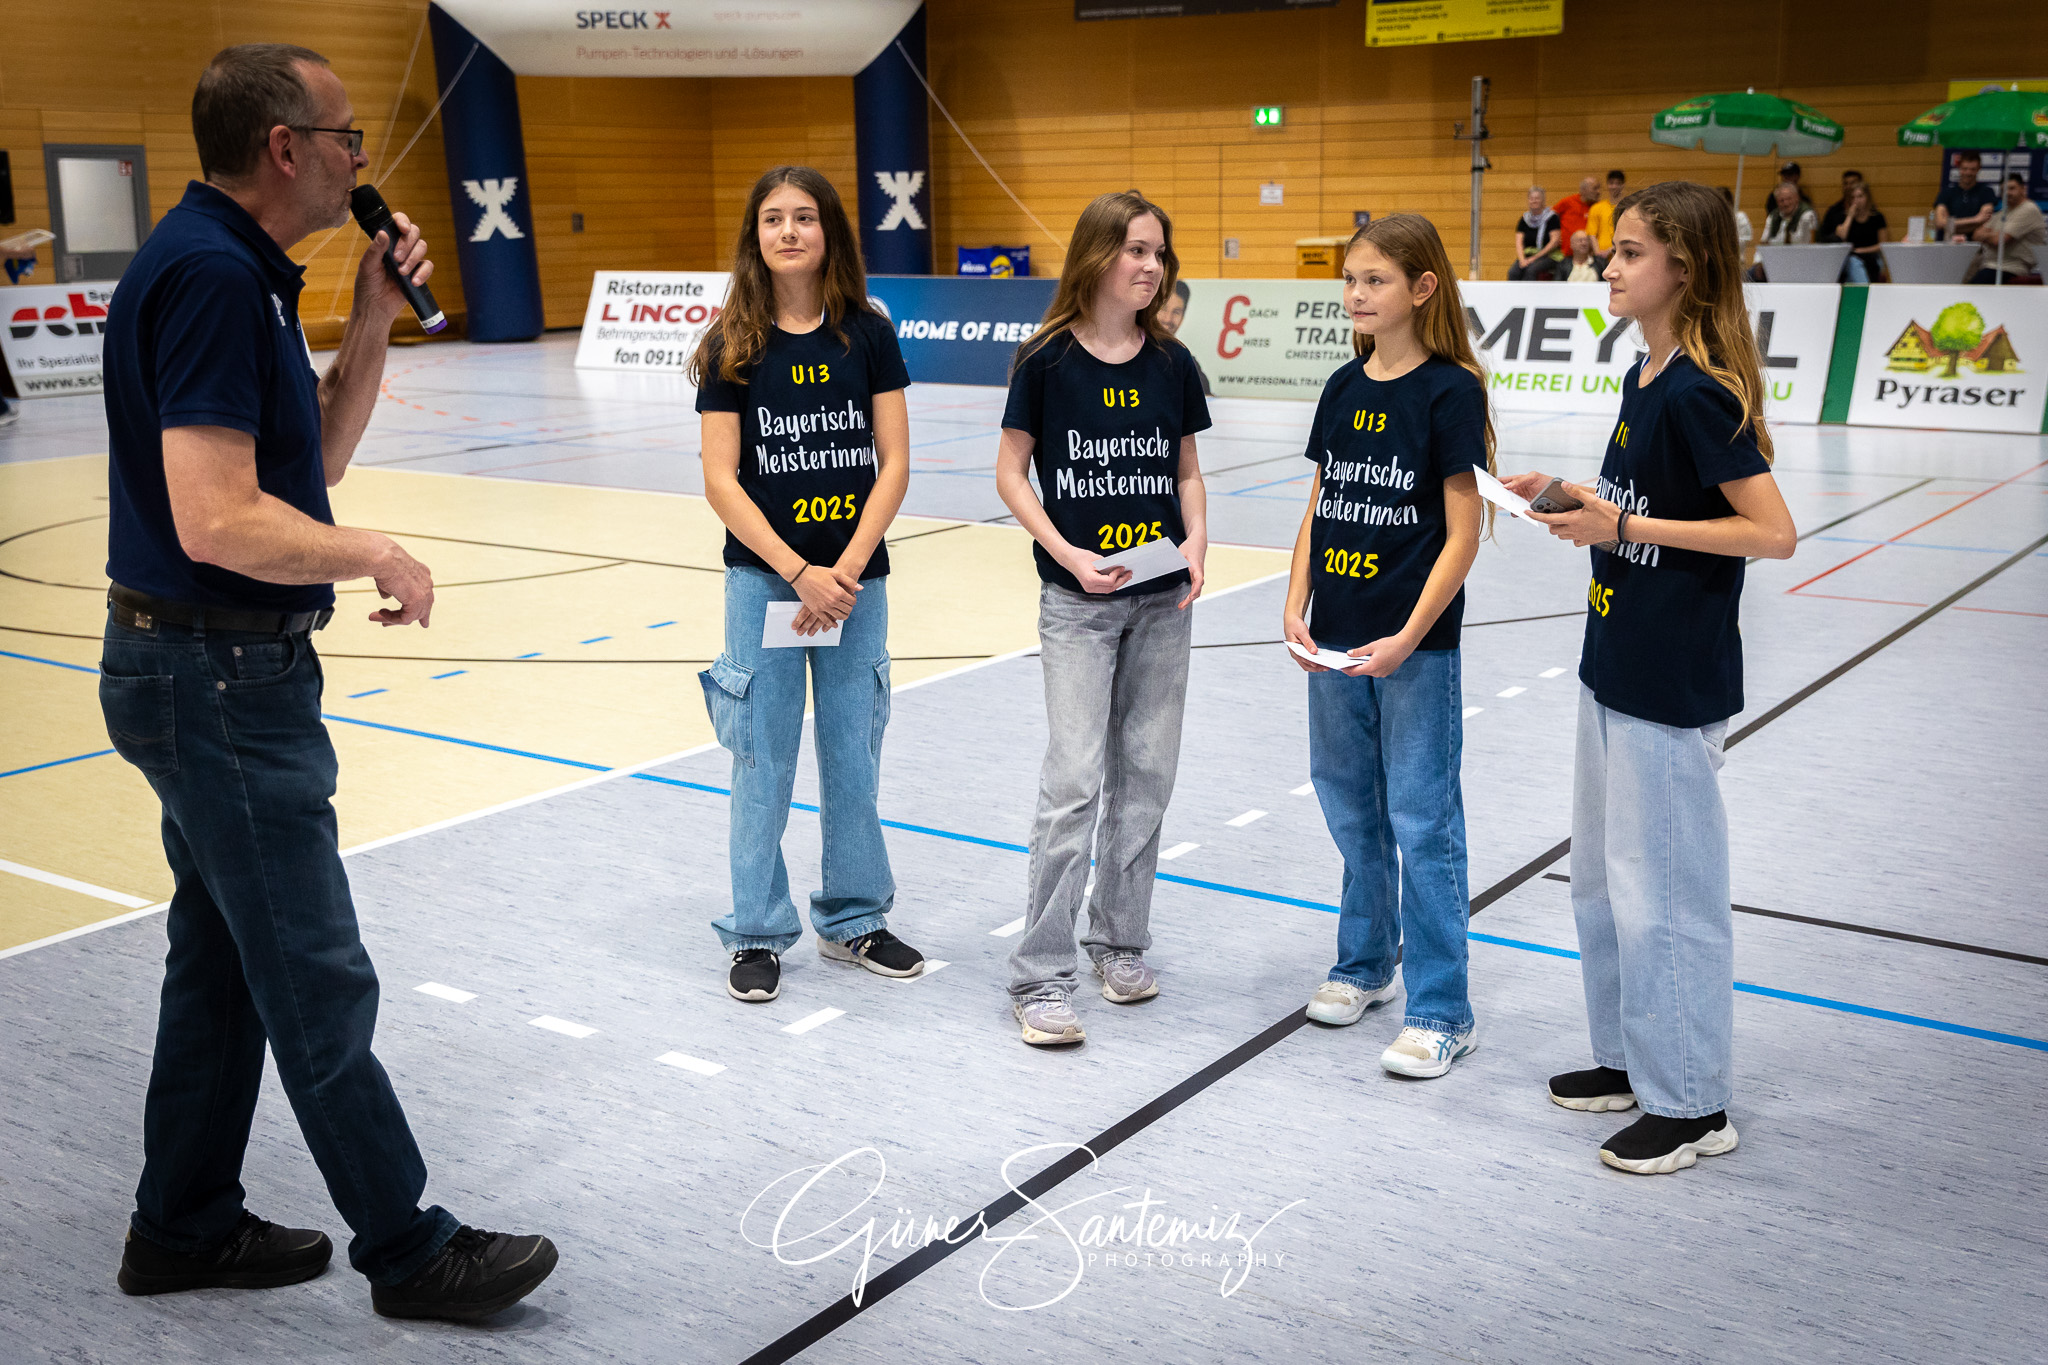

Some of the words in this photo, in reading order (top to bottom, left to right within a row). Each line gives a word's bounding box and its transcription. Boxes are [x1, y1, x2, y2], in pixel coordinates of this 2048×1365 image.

[576, 11, 649, 30] SPECK
[715, 47, 738, 60] und
[606, 280, 704, 296] Ristorante
[898, 319, 959, 341] HOME
[961, 321, 991, 341] OF
[1296, 327, 1352, 345] TRAI
[17, 357, 35, 369] Ihr
[614, 349, 640, 364] fon
[645, 349, 684, 366] 0911
[1285, 350, 1350, 361] CHRISTIAN
[791, 364, 830, 385] U13
[1103, 387, 1140, 408] U13
[1874, 379, 2026, 410] Pyraser
[1353, 409, 1387, 433] U13
[792, 493, 857, 524] 2025
[1097, 520, 1163, 550] 2025
[1324, 547, 1380, 579] 2025
